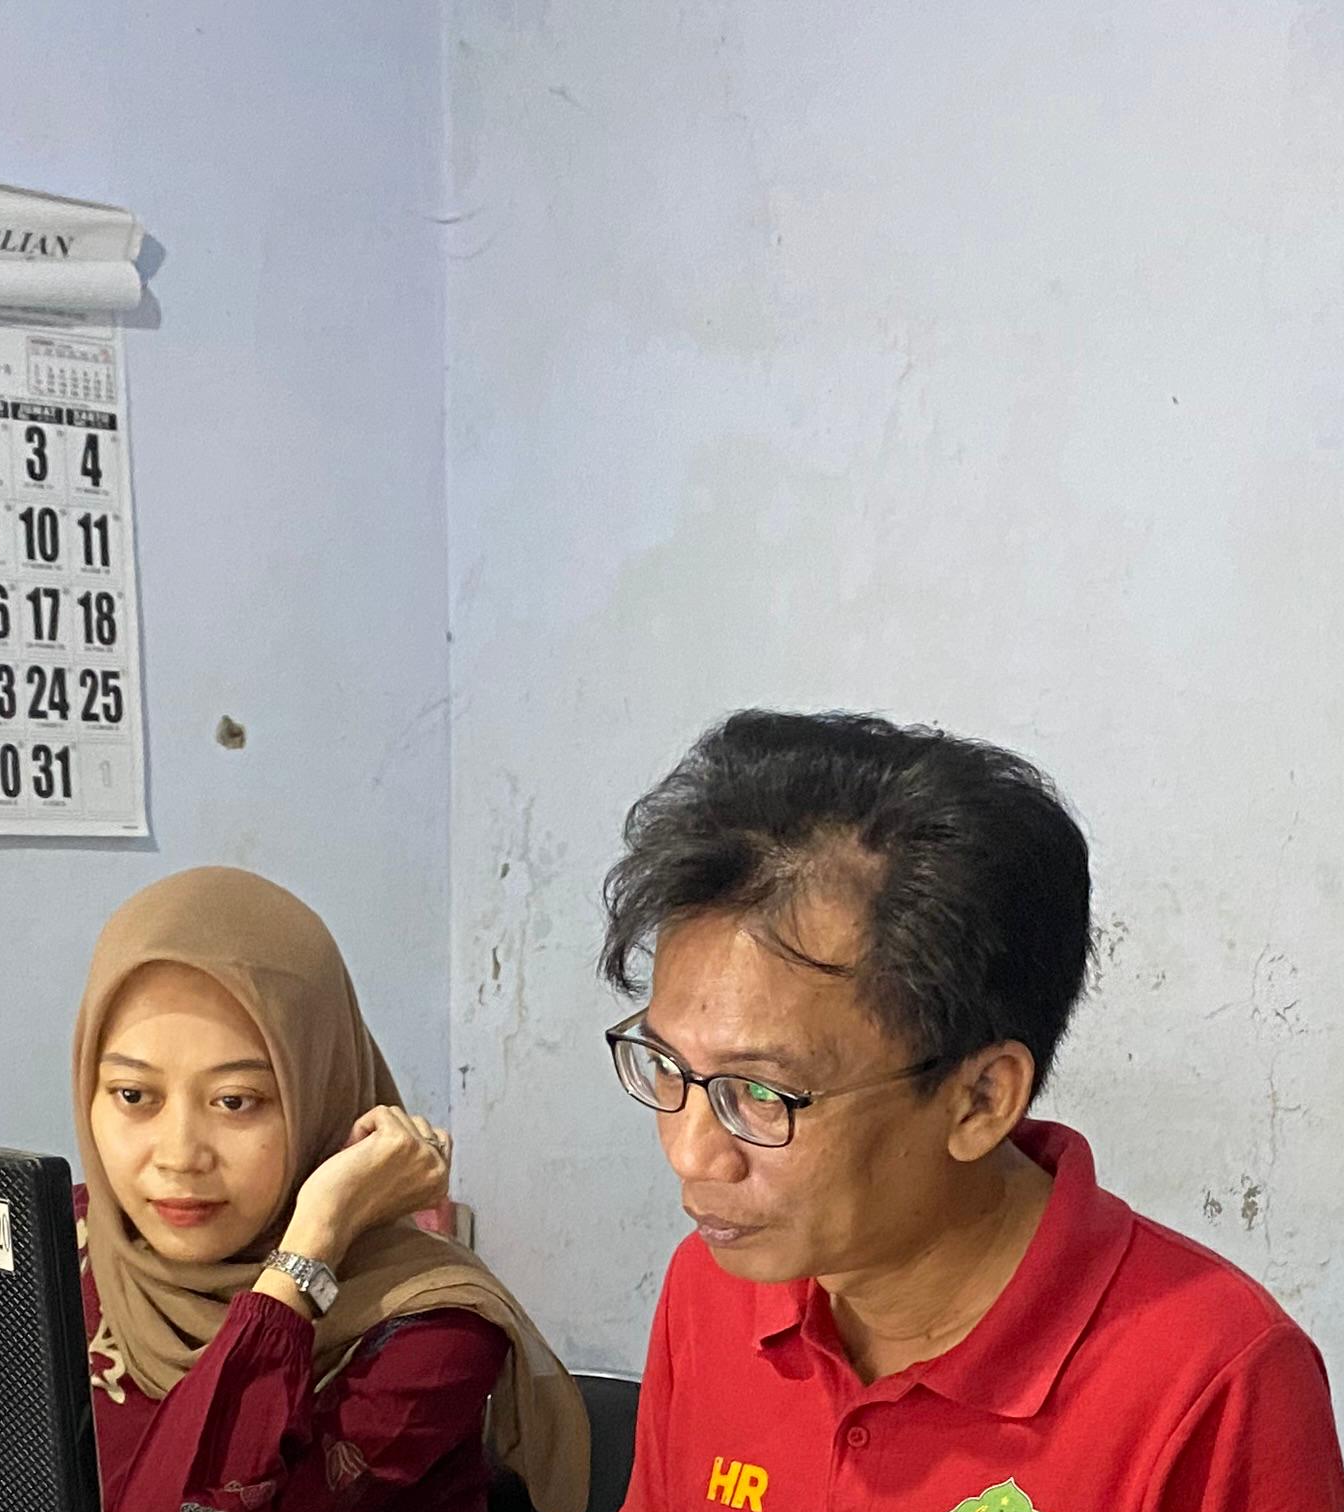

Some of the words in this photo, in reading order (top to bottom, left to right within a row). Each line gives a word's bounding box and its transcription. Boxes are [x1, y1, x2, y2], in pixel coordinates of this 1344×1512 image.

[25, 425, 48, 482] 3
[80, 433, 103, 488] 4
[18, 506, 60, 563] 10
[77, 512, 110, 567] 11
[26, 587, 60, 642] 17
[77, 590, 117, 646] 18
[26, 665, 70, 721] 24
[79, 668, 123, 724] 25
[31, 744, 72, 799] 31
